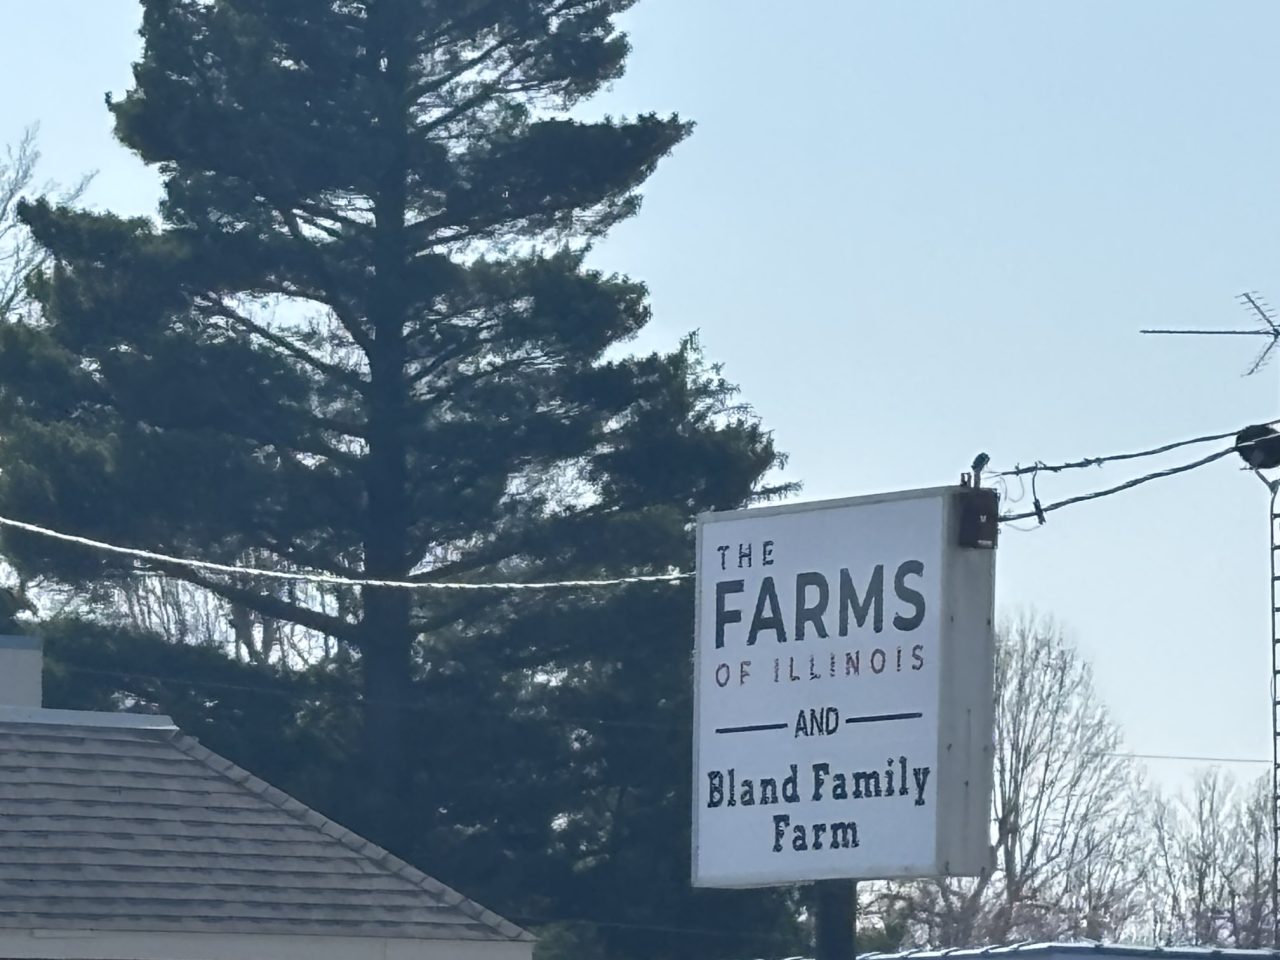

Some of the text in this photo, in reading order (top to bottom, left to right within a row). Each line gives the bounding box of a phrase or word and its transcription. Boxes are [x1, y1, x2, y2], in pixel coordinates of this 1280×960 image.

[716, 539, 775, 571] THE
[714, 559, 927, 650] FARMS
[715, 643, 925, 688] OF ILLINOIS
[793, 706, 840, 740] AND
[706, 755, 932, 809] Bland Family
[771, 813, 861, 854] Farm
